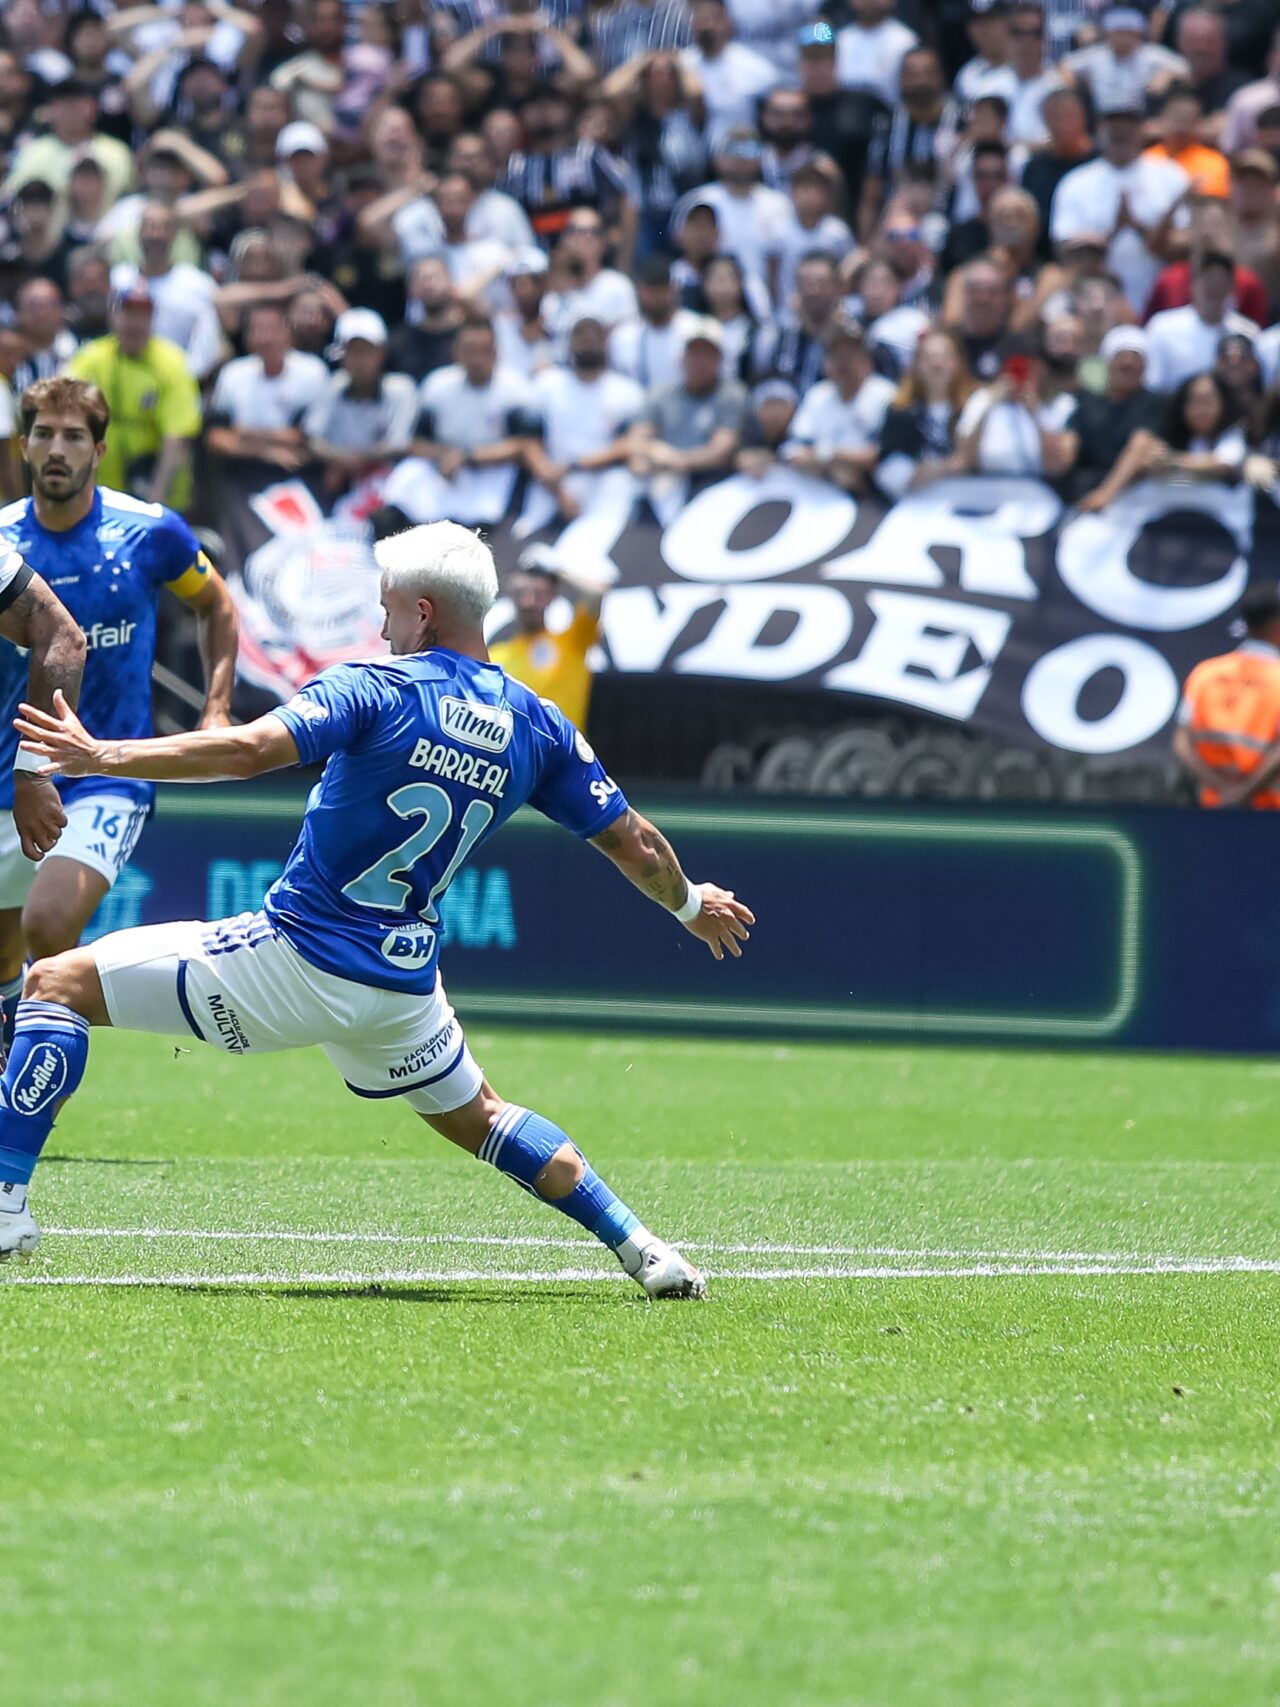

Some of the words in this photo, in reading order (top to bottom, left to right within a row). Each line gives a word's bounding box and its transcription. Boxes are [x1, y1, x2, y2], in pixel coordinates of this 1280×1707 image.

[443, 702, 508, 745] Vilma
[409, 738, 510, 798] BARREAL
[92, 805, 121, 839] 16
[341, 782, 494, 923] 21
[387, 934, 434, 959] BH
[17, 1049, 59, 1110] Kodilar
